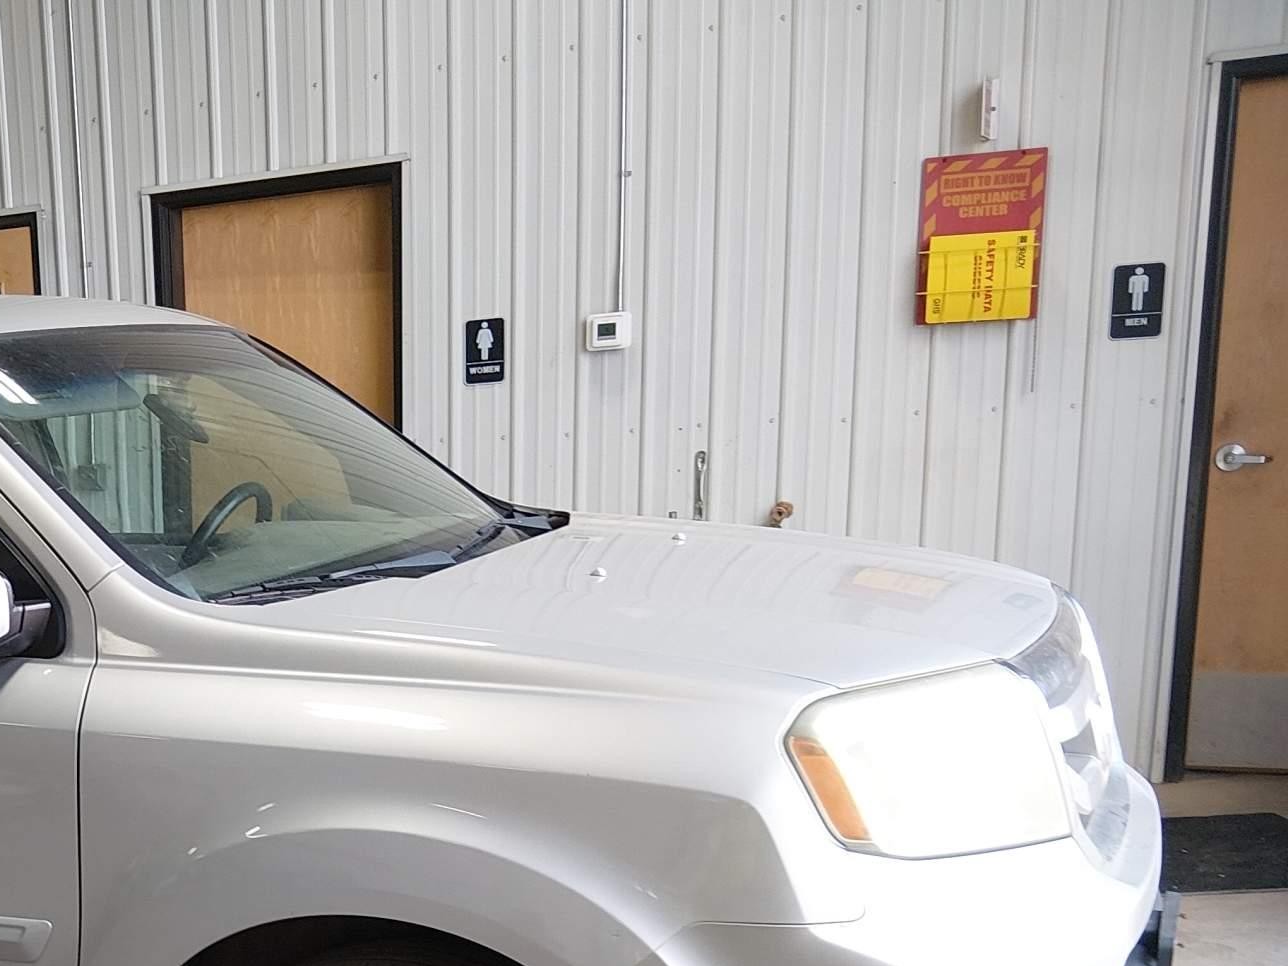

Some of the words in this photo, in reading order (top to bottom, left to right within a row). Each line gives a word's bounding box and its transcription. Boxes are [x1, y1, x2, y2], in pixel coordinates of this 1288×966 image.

[976, 174, 992, 188] TO
[942, 189, 1027, 207] COMPLIANCE
[959, 203, 1008, 218] CENTER
[984, 239, 996, 282] SAFETY
[468, 364, 501, 375] WOMEN
